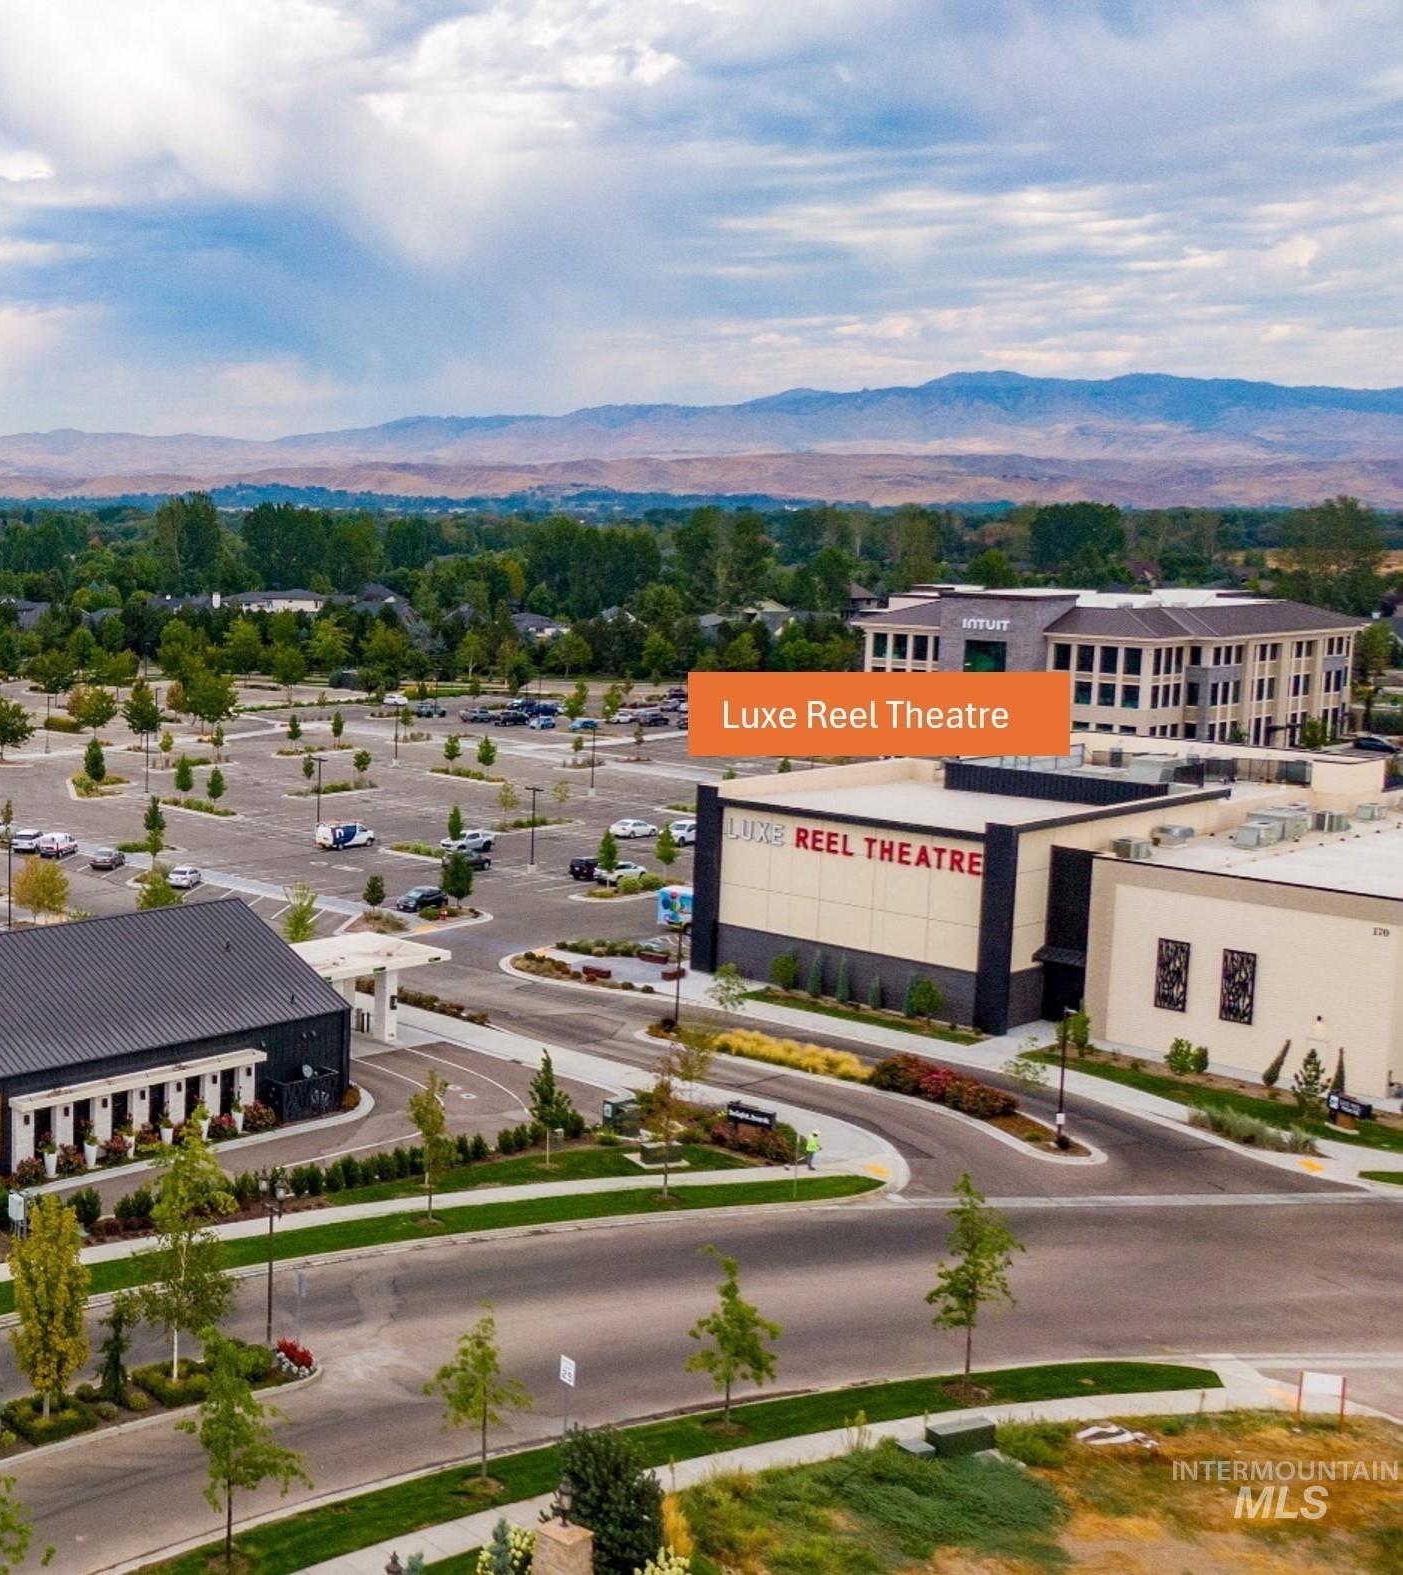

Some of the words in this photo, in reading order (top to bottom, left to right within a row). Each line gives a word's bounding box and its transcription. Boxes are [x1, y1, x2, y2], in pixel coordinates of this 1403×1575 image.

[962, 618, 1010, 631] INTUIT
[726, 817, 786, 847] LUXE
[795, 826, 854, 857] REEL
[864, 836, 984, 877] THEATRE
